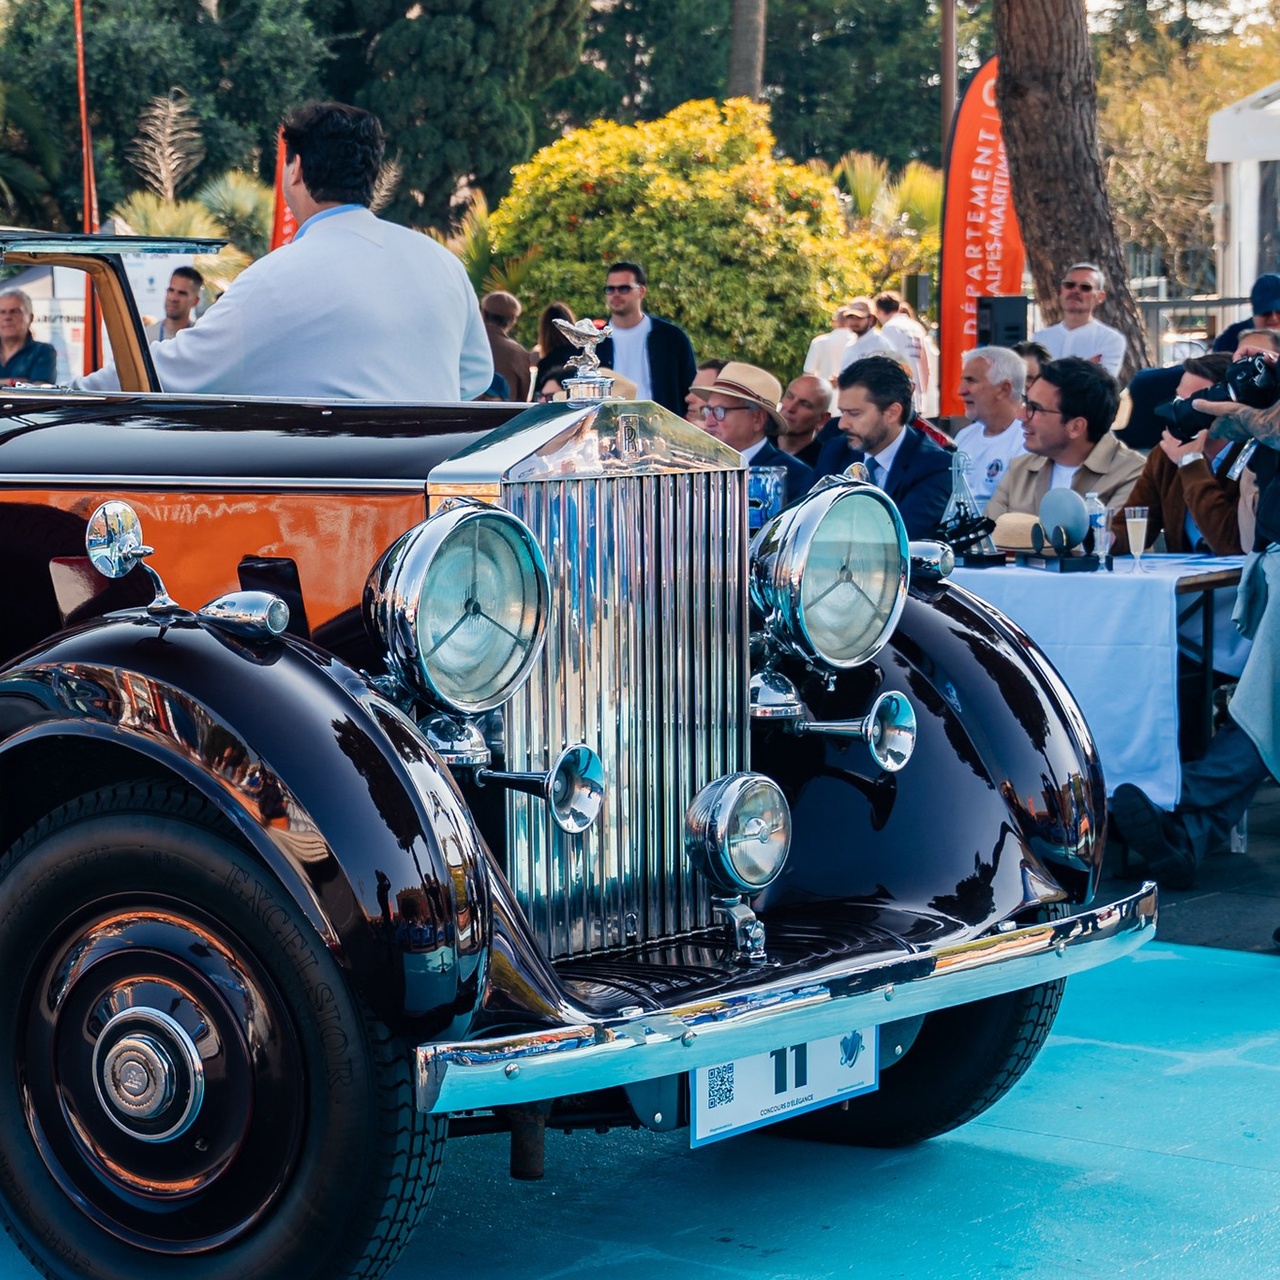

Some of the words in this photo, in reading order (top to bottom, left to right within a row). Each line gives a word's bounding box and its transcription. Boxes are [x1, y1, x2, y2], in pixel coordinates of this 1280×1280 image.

[959, 128, 996, 336] DÉPARTEMENT
[222, 862, 354, 1090] EXCELSIOR
[760, 1102, 787, 1116] CONCOURS
[770, 1042, 808, 1095] 11
